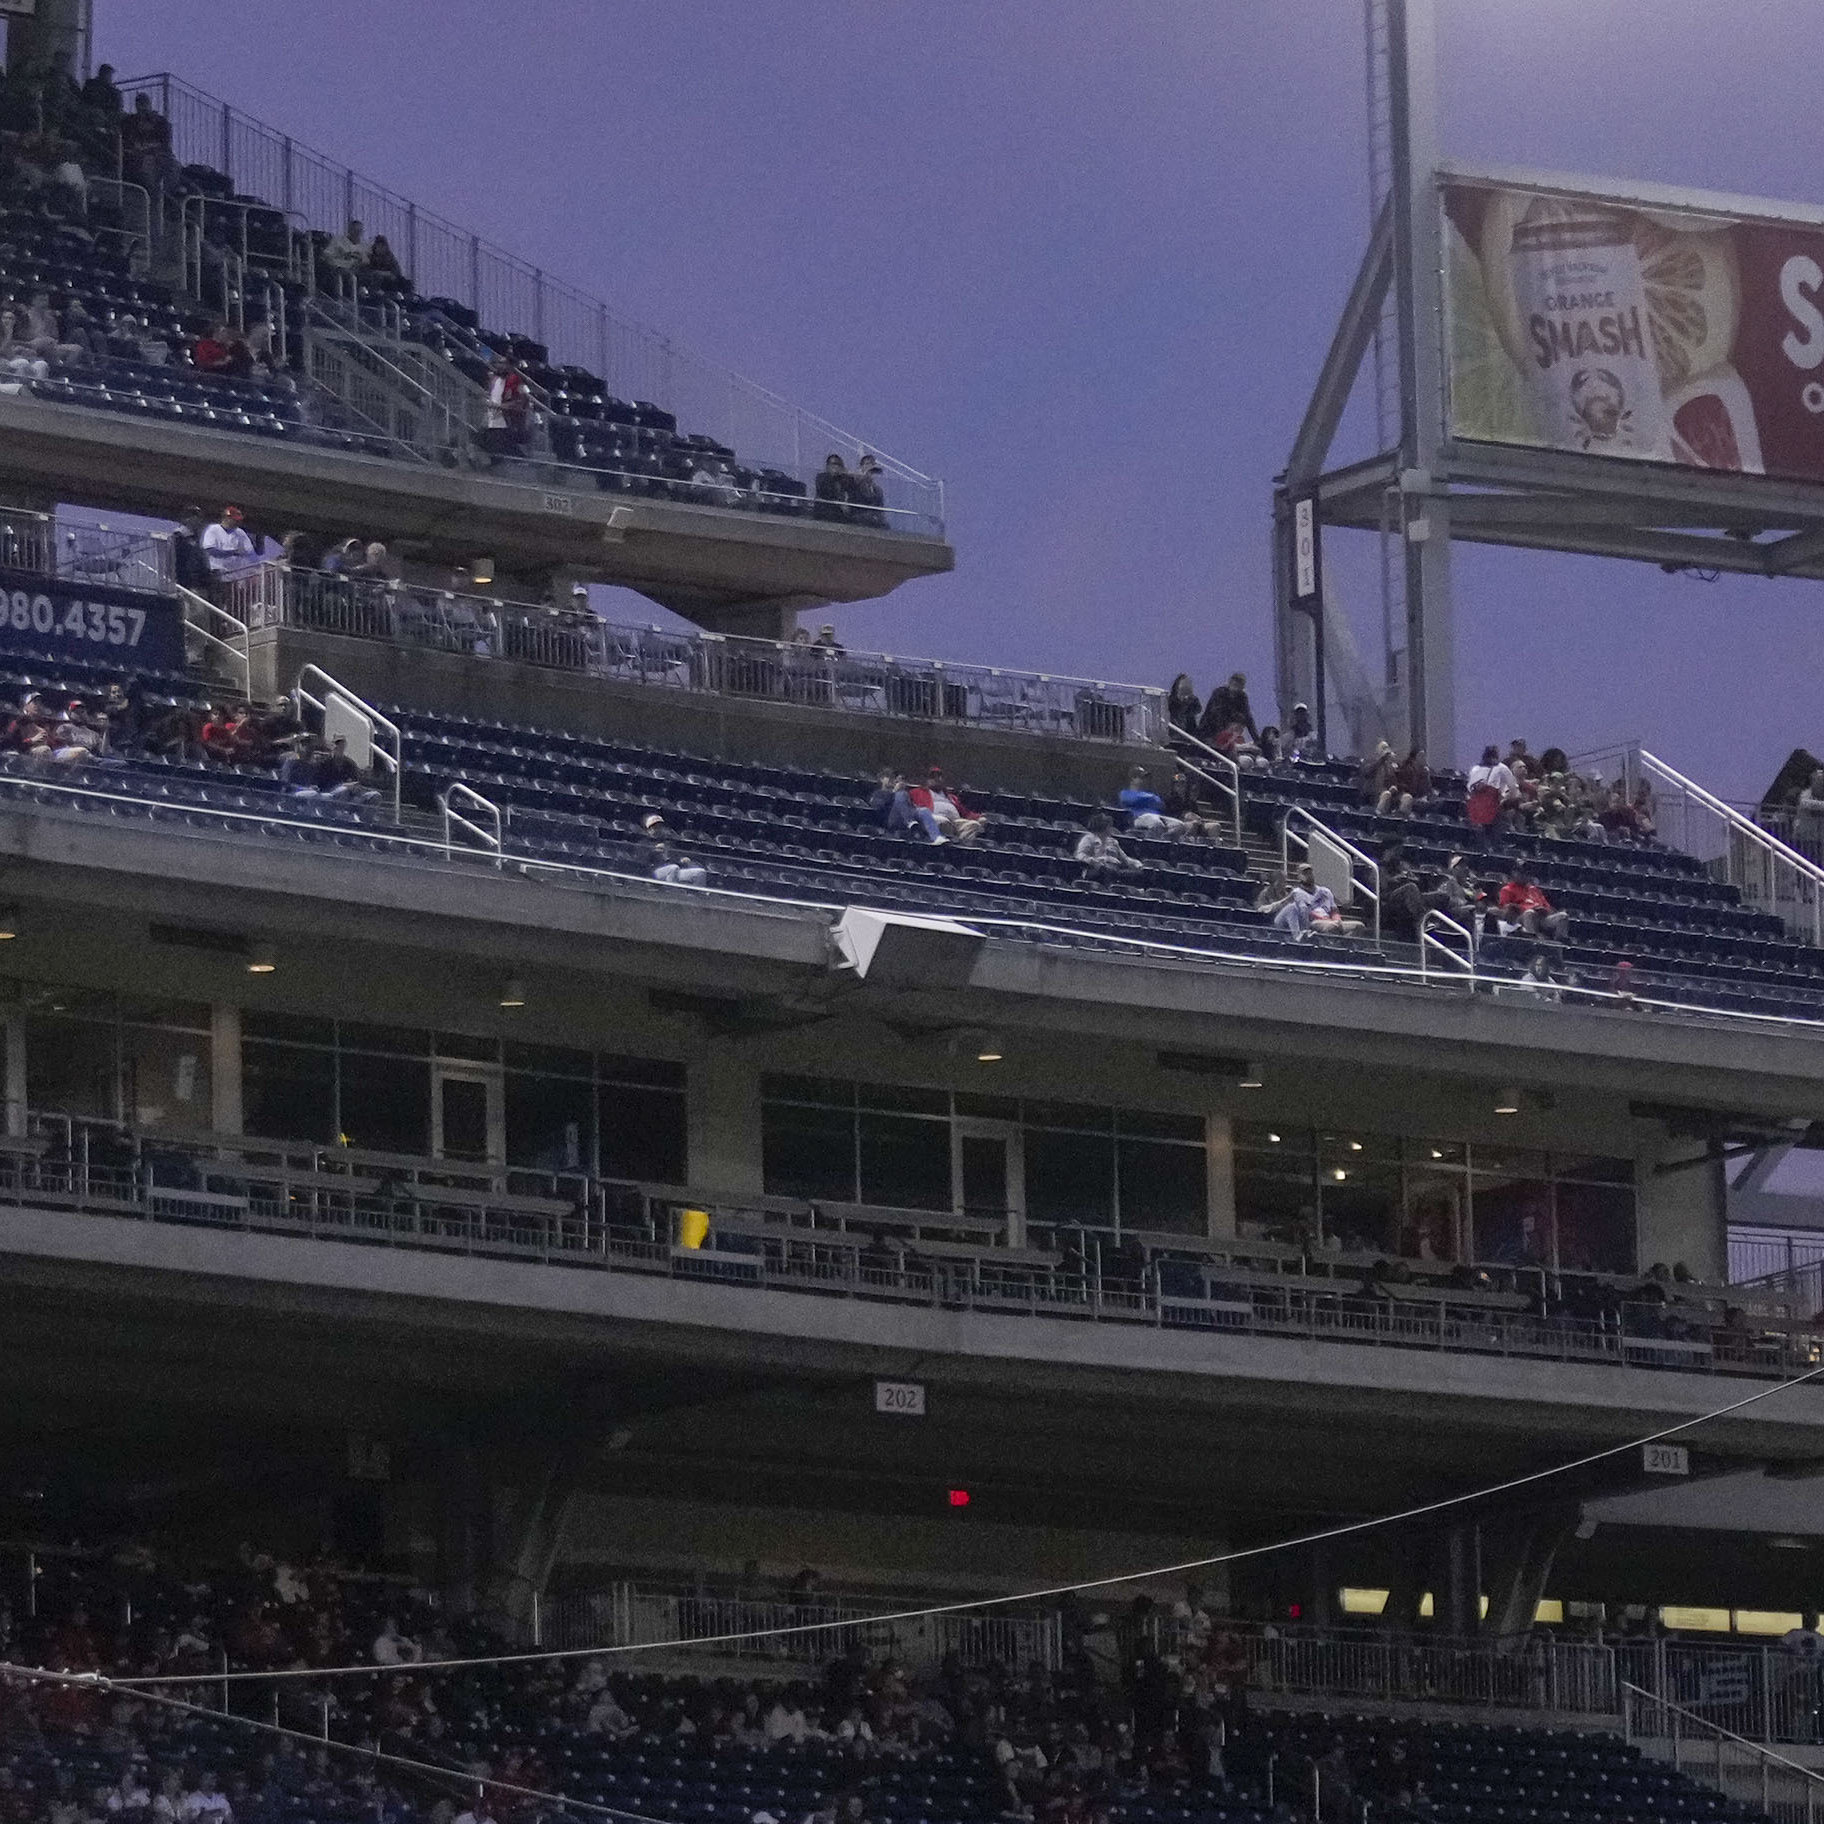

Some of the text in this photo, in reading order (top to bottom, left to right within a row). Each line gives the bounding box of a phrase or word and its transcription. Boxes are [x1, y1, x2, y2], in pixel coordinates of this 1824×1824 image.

[1530, 306, 1646, 368] SMASH
[885, 1389, 915, 1408] 202
[1648, 1450, 1678, 1469] 201
